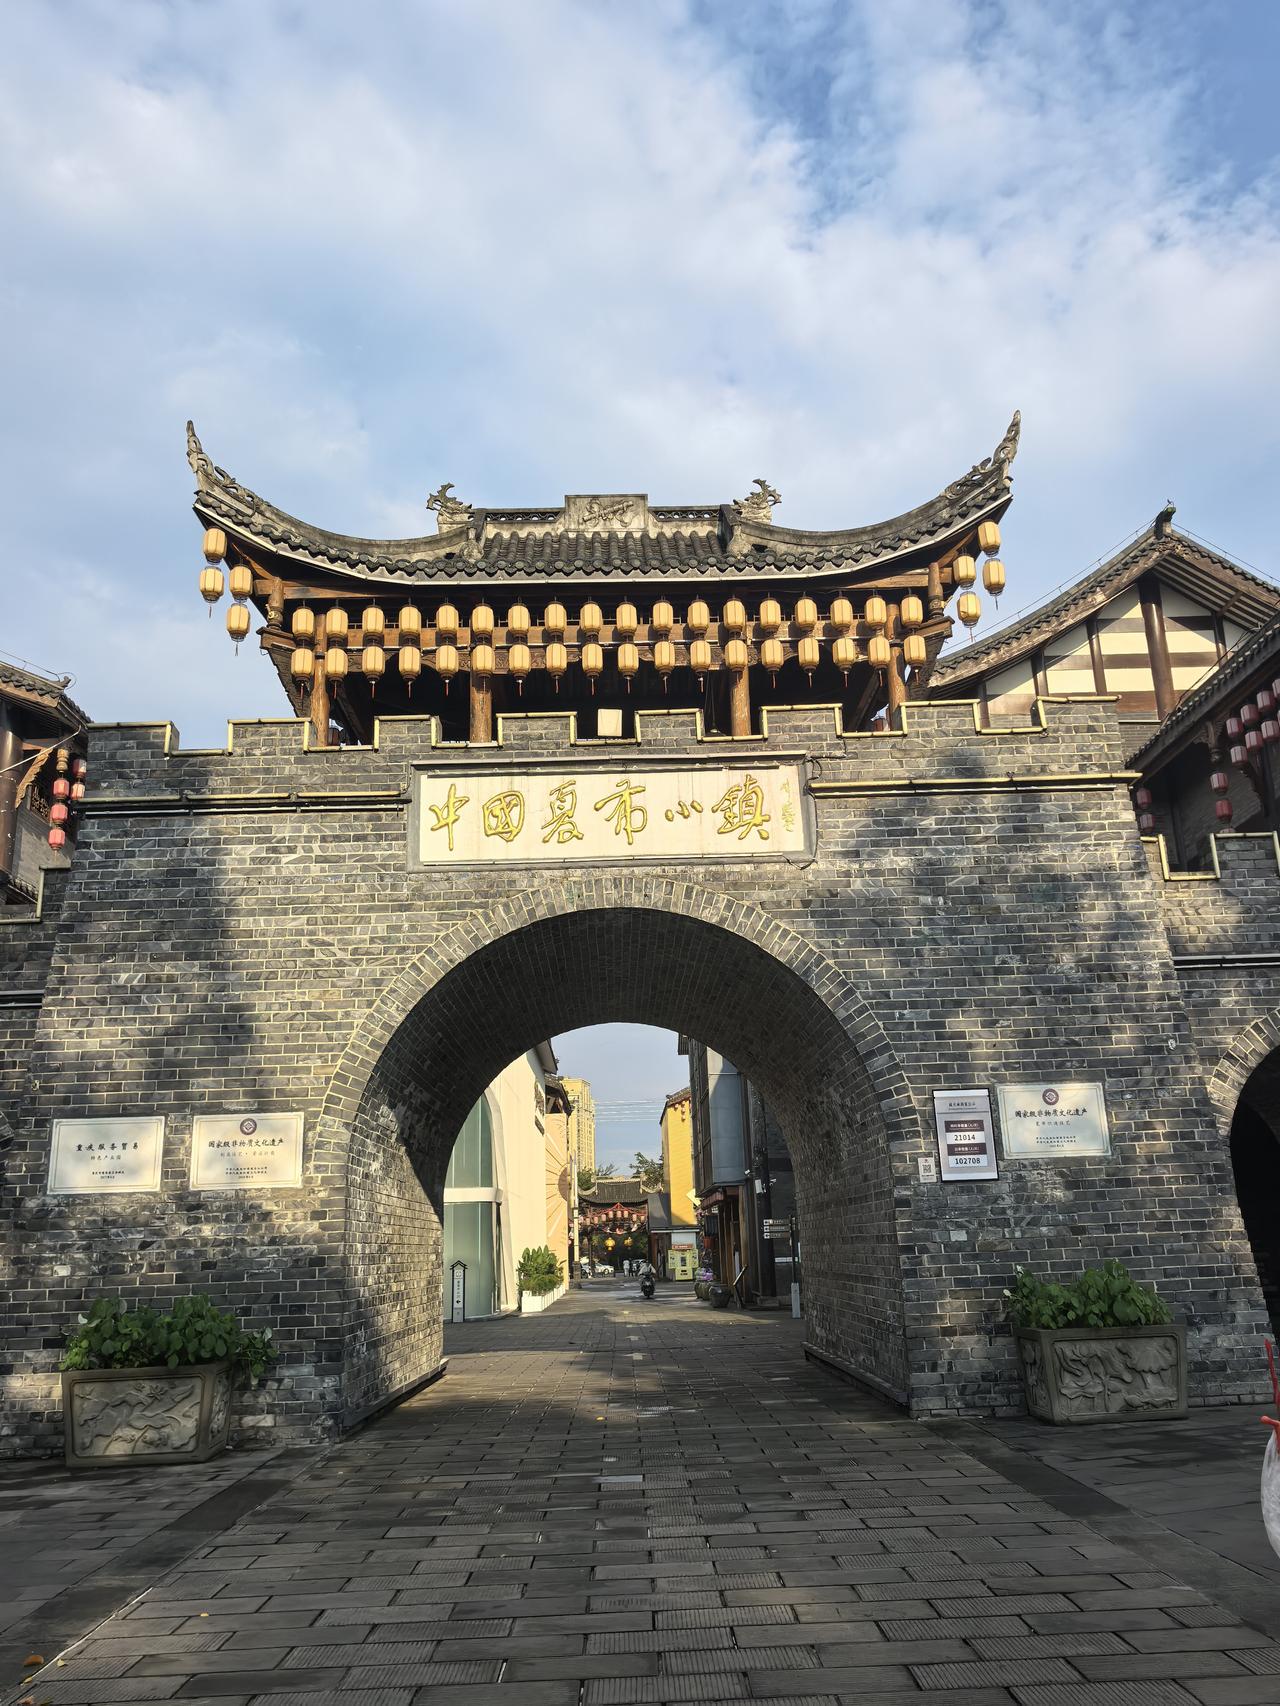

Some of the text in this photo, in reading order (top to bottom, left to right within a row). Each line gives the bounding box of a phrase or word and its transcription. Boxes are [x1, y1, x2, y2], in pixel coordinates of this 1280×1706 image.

[429, 773, 770, 851] 中國夏布小鎮
[1014, 1108, 1088, 1118] 国家级非物质文化遗产
[208, 1138, 284, 1148] 国家级非物质文化遗产
[955, 1157, 981, 1165] 102708
